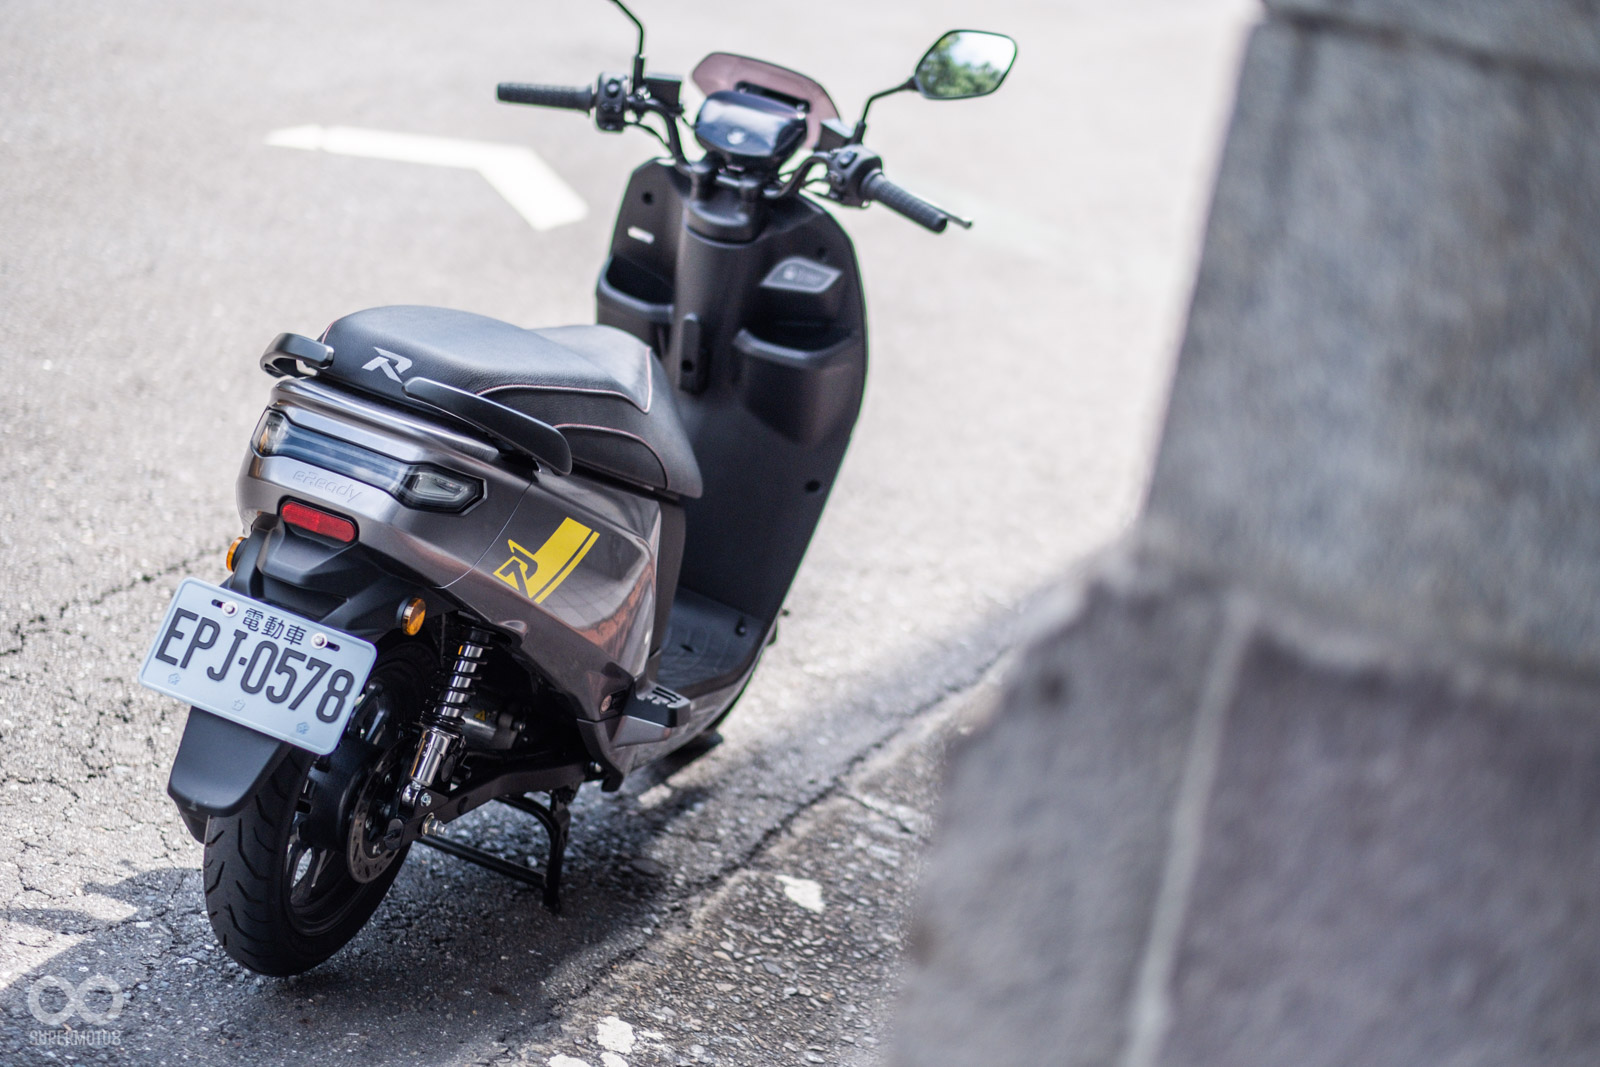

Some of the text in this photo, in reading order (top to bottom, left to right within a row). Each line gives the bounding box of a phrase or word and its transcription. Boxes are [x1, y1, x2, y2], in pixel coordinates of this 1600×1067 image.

[292, 470, 363, 503] eReady
[242, 607, 307, 646] 電動車
